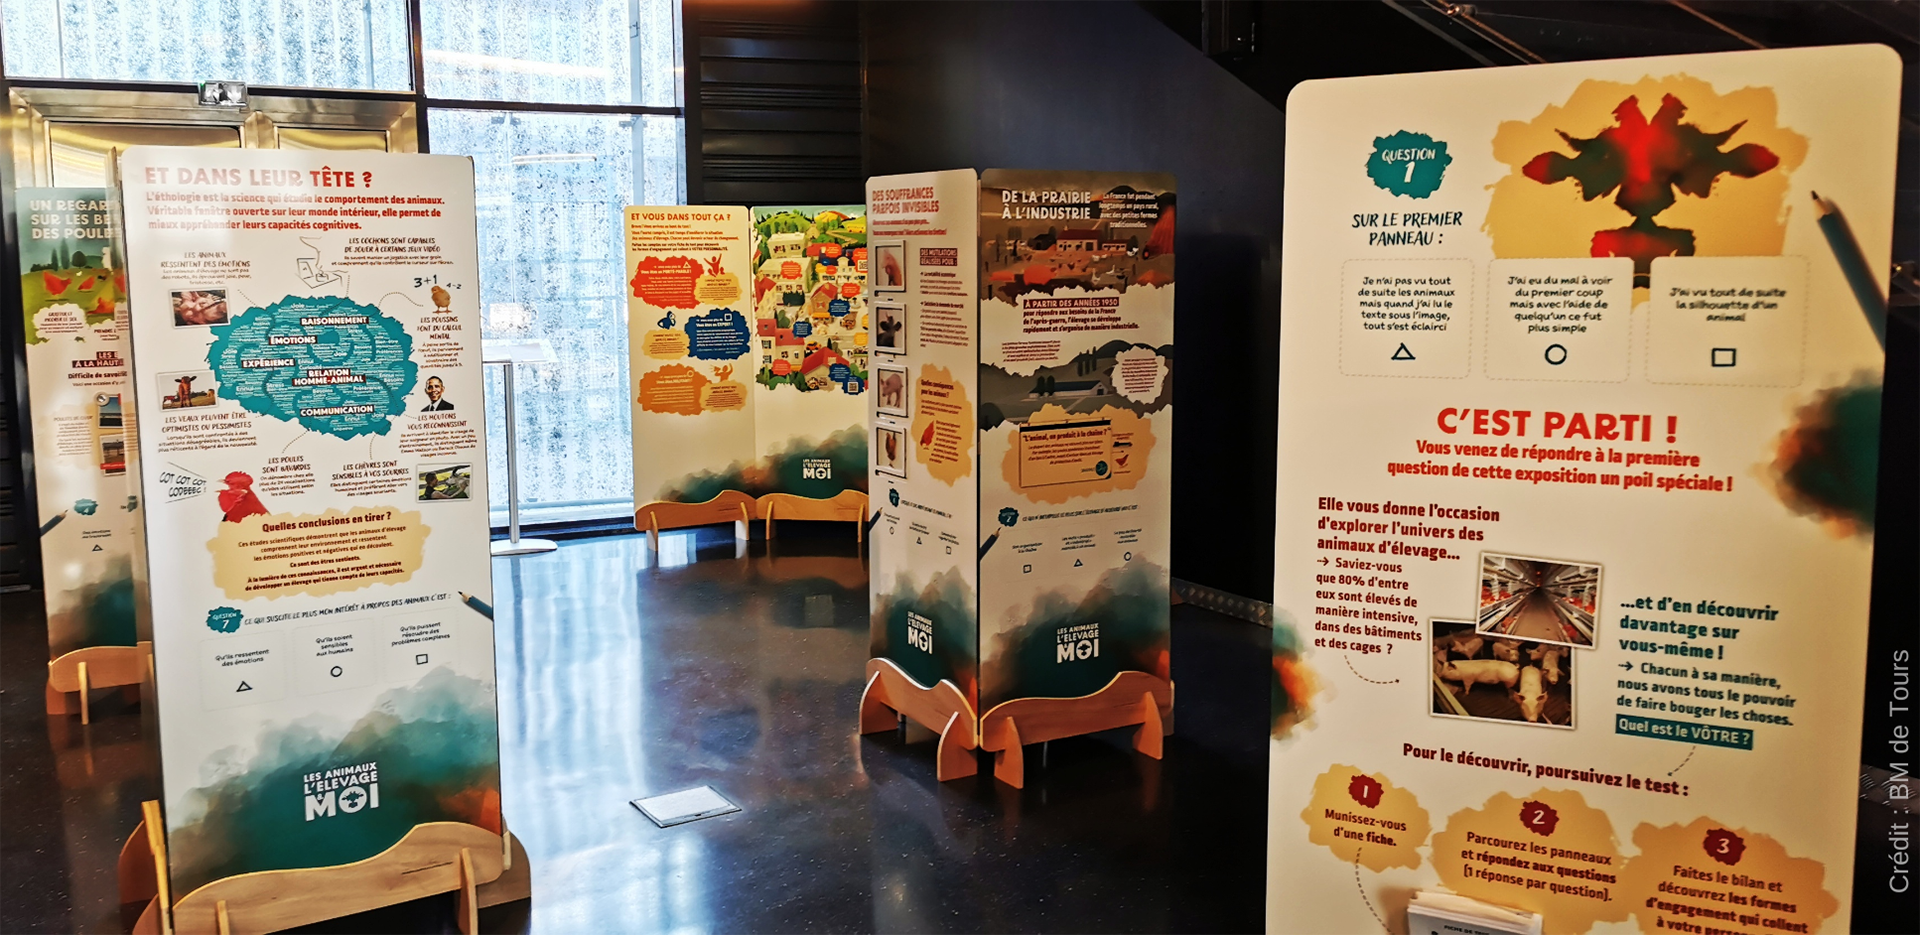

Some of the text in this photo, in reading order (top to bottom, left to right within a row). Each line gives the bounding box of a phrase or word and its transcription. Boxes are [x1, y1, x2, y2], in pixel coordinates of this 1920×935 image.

[1382, 148, 1435, 164] QUESTION
[145, 167, 169, 184] ET
[177, 168, 241, 185] DANS
[250, 169, 303, 186] LEUR
[310, 166, 355, 188] TÊTE
[1404, 161, 1415, 182] 1
[872, 186, 933, 201] DES SOUFFRANCES
[1002, 190, 1090, 204] DE LA PRAIRIE
[30, 200, 51, 211] UN
[289, 207, 306, 216] leur
[308, 207, 338, 216] monde
[340, 207, 380, 217] intérieur,
[382, 208, 397, 216] elle
[399, 209, 429, 218] permet
[431, 208, 441, 217] de
[1002, 206, 1090, 220] À L'INDUSTRIE
[31, 214, 60, 225] SUR
[65, 214, 89, 225] LES
[243, 220, 266, 228] leurs
[268, 220, 311, 230] capacités
[714, 214, 724, 222] ÇA
[1352, 211, 1462, 228] SUR LE PREMIER
[32, 228, 60, 239] DES
[1369, 230, 1433, 246] PANNEAU
[1363, 276, 1374, 285] Je
[1395, 278, 1412, 286] pas
[1428, 277, 1450, 285] tout
[1025, 299, 1031, 308] À
[1032, 300, 1057, 308] PARTIR
[1074, 298, 1100, 307] ANNÉES
[301, 317, 367, 325] RAISONNEMENT
[271, 335, 316, 344] ÉMOTIONS
[243, 358, 295, 368] EXPÉRIENCE
[294, 376, 363, 385] HOMME-ANIMAL
[308, 369, 349, 377] RELATION
[300, 406, 374, 416] COMMUNICATION
[1437, 407, 1531, 436] C'EST
[1544, 411, 1651, 442] PARTI
[1416, 439, 1700, 467] Vous venez de répondre à la première
[803, 468, 831, 479] MOI
[1387, 460, 1448, 476] question
[1452, 462, 1469, 477] de
[1472, 465, 1512, 479] cette
[1515, 467, 1596, 484] exposition
[1600, 474, 1619, 485] un
[1623, 471, 1653, 489] poil
[1656, 473, 1723, 492] spéciale
[1318, 497, 1499, 521] Elle vous donne l'occasion
[262, 522, 296, 532] Quelles
[298, 516, 350, 528] conclusions
[364, 513, 384, 521] tirer
[1318, 516, 1483, 541] d'explorer l'univers des
[1317, 536, 1374, 552] animaux
[1336, 557, 1402, 572] Saviez-vous
[1316, 574, 1408, 590] que 80% d'entre
[1657, 597, 1691, 613] d'en
[1697, 600, 1778, 620] découvrir
[223, 619, 229, 628] 7
[1069, 623, 1099, 632] ANIMAUX
[1620, 615, 1739, 639] davantage sur
[1057, 638, 1099, 664] MOI
[1619, 639, 1713, 658] vous-même
[1619, 718, 1648, 732] Quel
[1651, 724, 1672, 735] est
[1676, 724, 1688, 737] le
[1691, 727, 1738, 743] VÔTRE
[304, 762, 377, 782] LES ANIMAUX
[1403, 743, 1437, 759] Pour
[1440, 748, 1453, 762] le
[1457, 751, 1531, 776] découvrir,
[1536, 765, 1622, 786] poursuivez
[1626, 774, 1640, 789] le
[1644, 777, 1679, 795] test
[304, 771, 378, 794] L'ELEVAGE
[305, 783, 379, 821] MOI
[1325, 808, 1406, 831] Munissez-vous
[1532, 810, 1544, 824] 2
[1334, 826, 1396, 846] d'une fiche.
[1467, 831, 1611, 865] Parcourez les panneaux
[1717, 838, 1729, 853] 3
